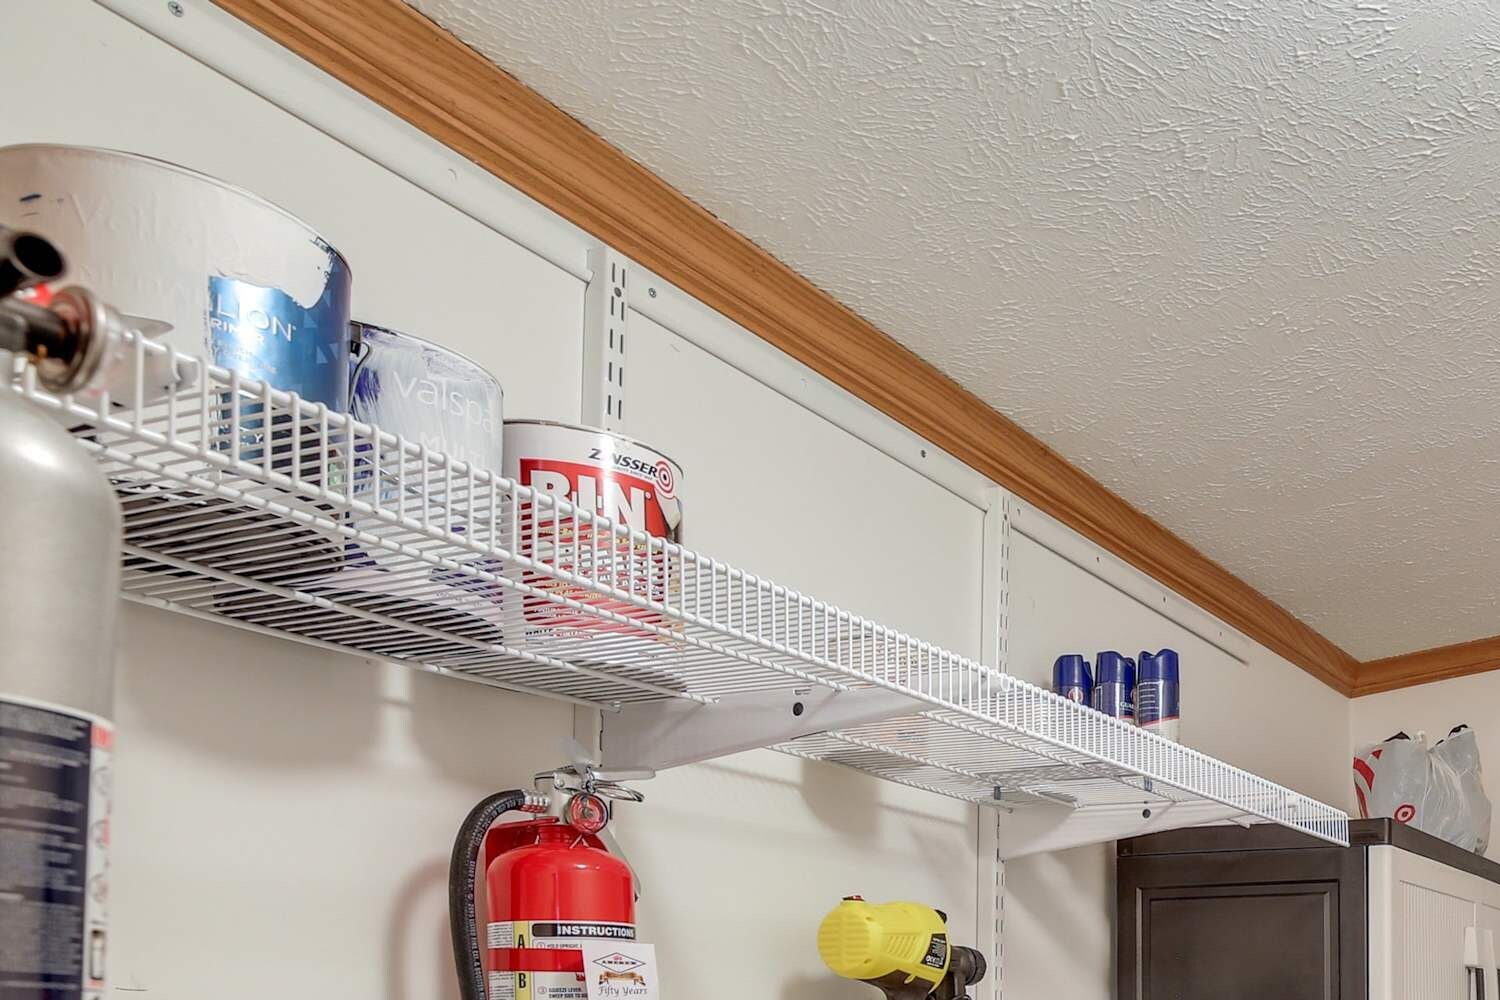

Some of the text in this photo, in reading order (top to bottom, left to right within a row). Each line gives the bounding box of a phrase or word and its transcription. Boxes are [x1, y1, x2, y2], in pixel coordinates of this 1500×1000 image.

[588, 448, 658, 478] ZNSSER
[557, 926, 635, 937] INSTRUCTIONS
[518, 935, 526, 948] A
[518, 973, 526, 988] B
[598, 986, 648, 997] Fifty Years
